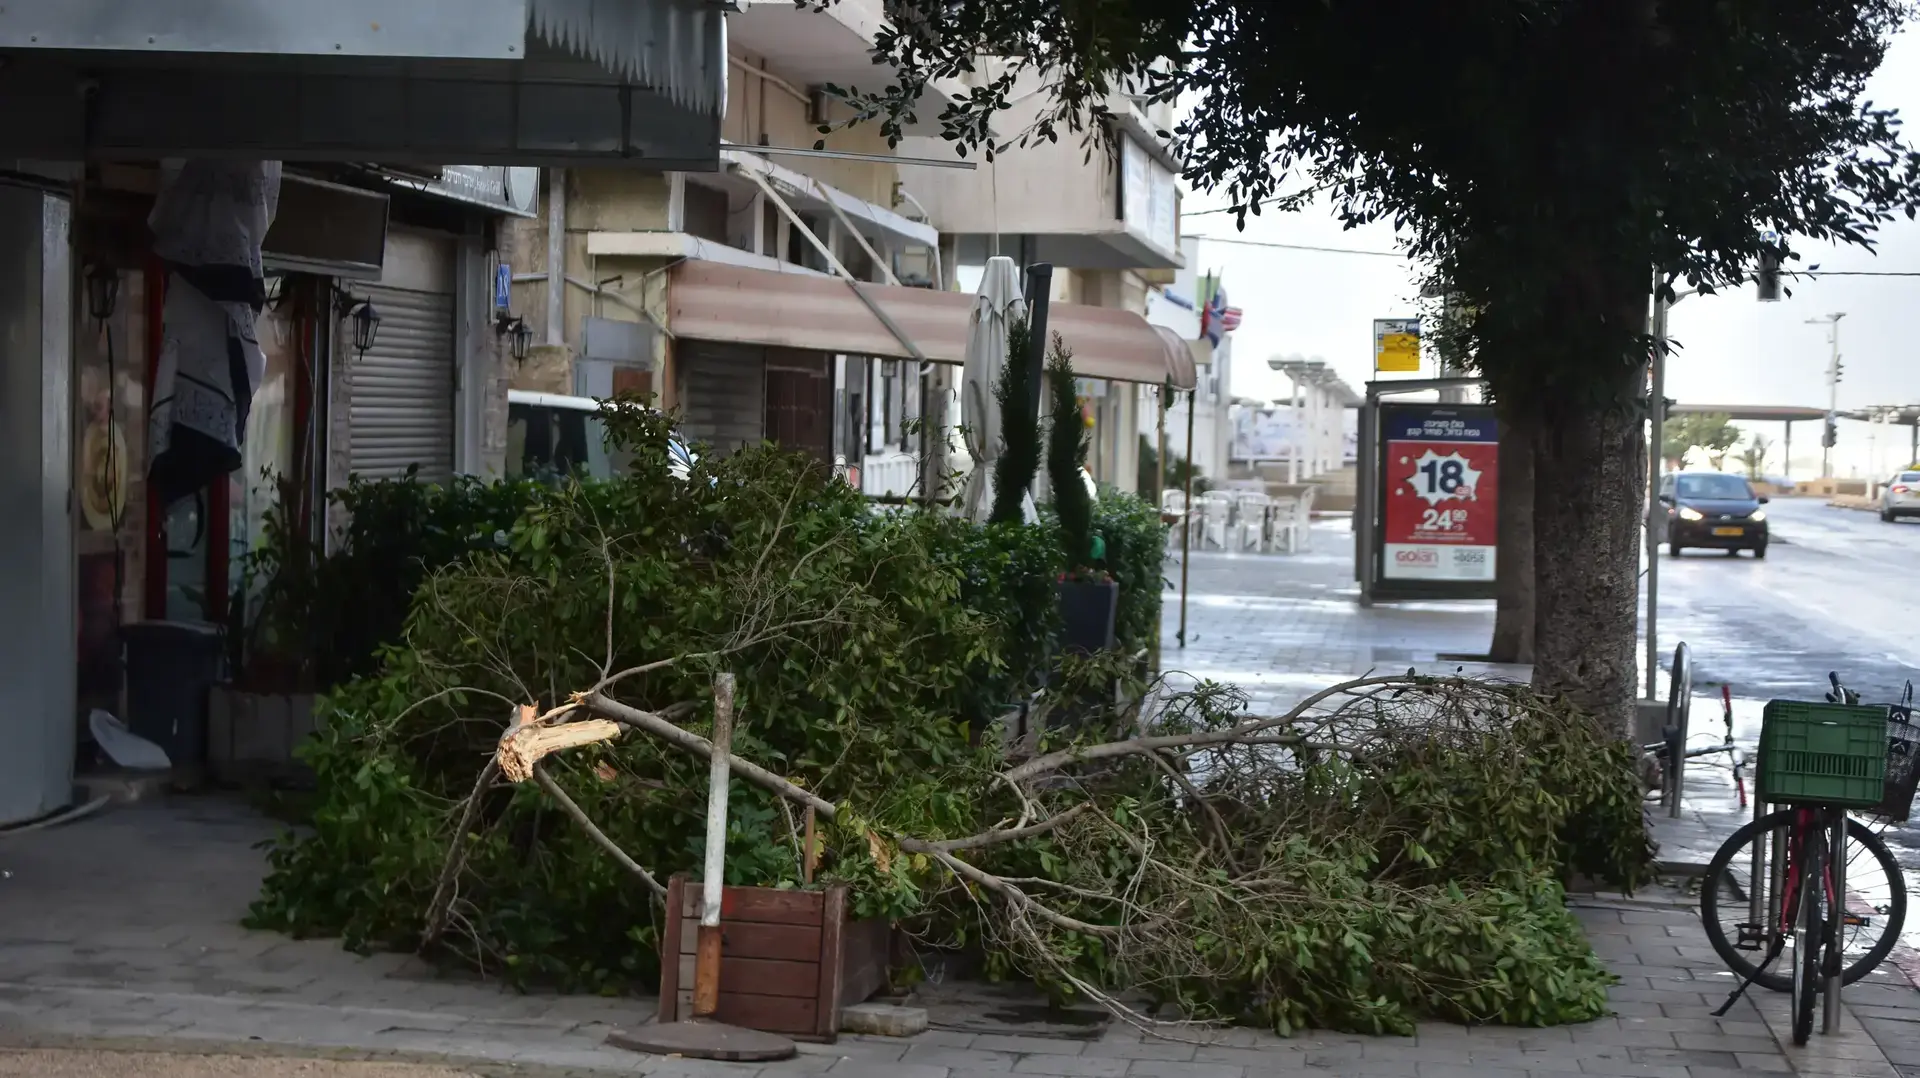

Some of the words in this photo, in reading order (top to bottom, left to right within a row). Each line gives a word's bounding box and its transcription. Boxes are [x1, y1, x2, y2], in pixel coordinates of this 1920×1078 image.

[499, 273, 509, 298] 18
[1420, 459, 1464, 494] 18
[1422, 508, 1453, 531] 24
